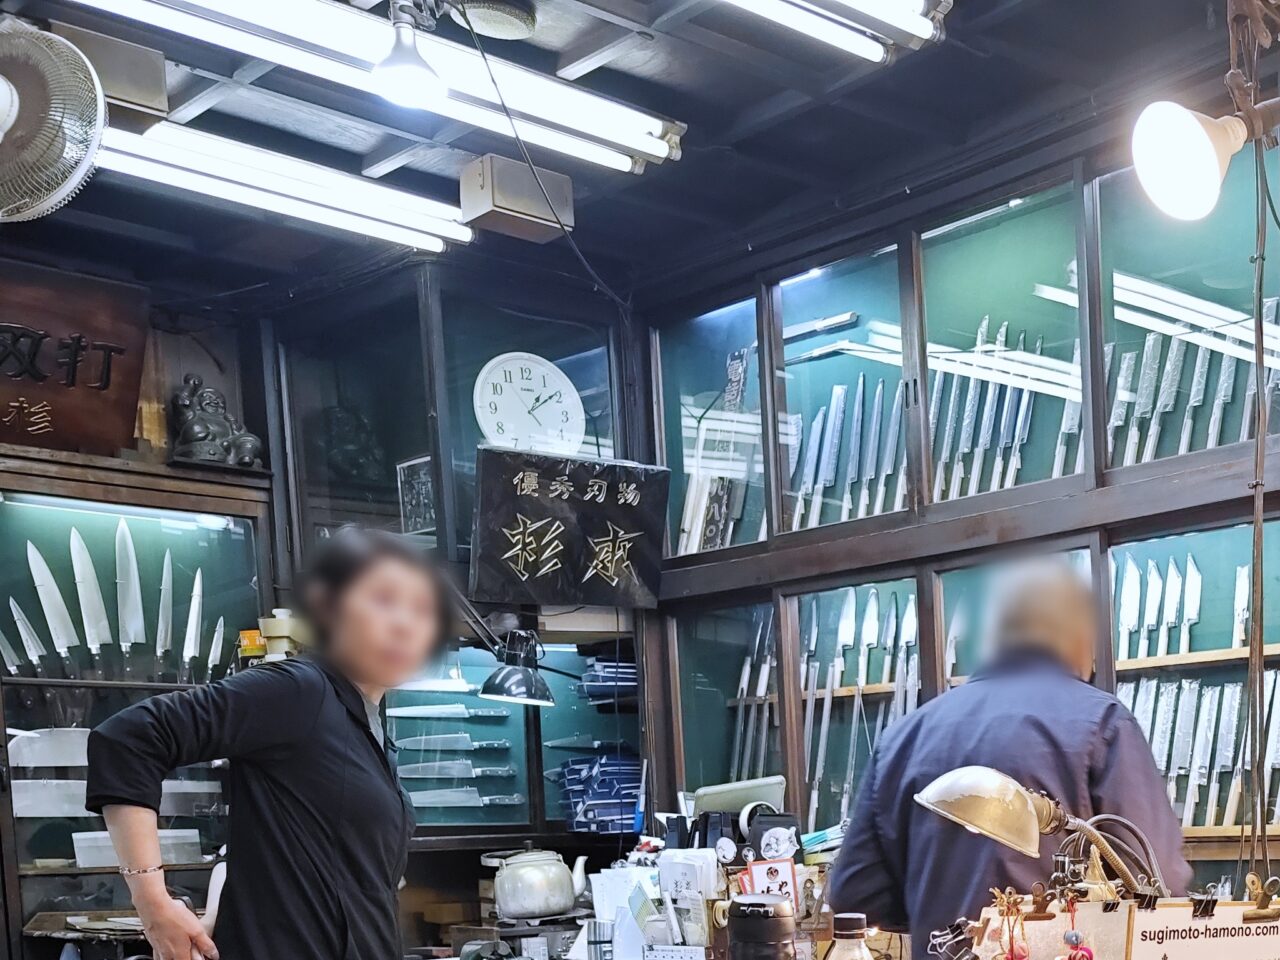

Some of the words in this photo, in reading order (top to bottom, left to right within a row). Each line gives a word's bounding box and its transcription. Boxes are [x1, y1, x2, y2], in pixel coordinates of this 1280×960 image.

[503, 369, 513, 383] 11
[520, 367, 532, 381] 12
[541, 375, 547, 388] 1
[491, 382, 503, 396] 10
[555, 391, 563, 403] 2
[489, 402, 497, 414] 9
[561, 410, 569, 423] 3
[496, 422, 504, 435] 8
[513, 471, 642, 507] 優秀刃物
[1140, 925, 1279, 945] sugimoto-hamono.com
